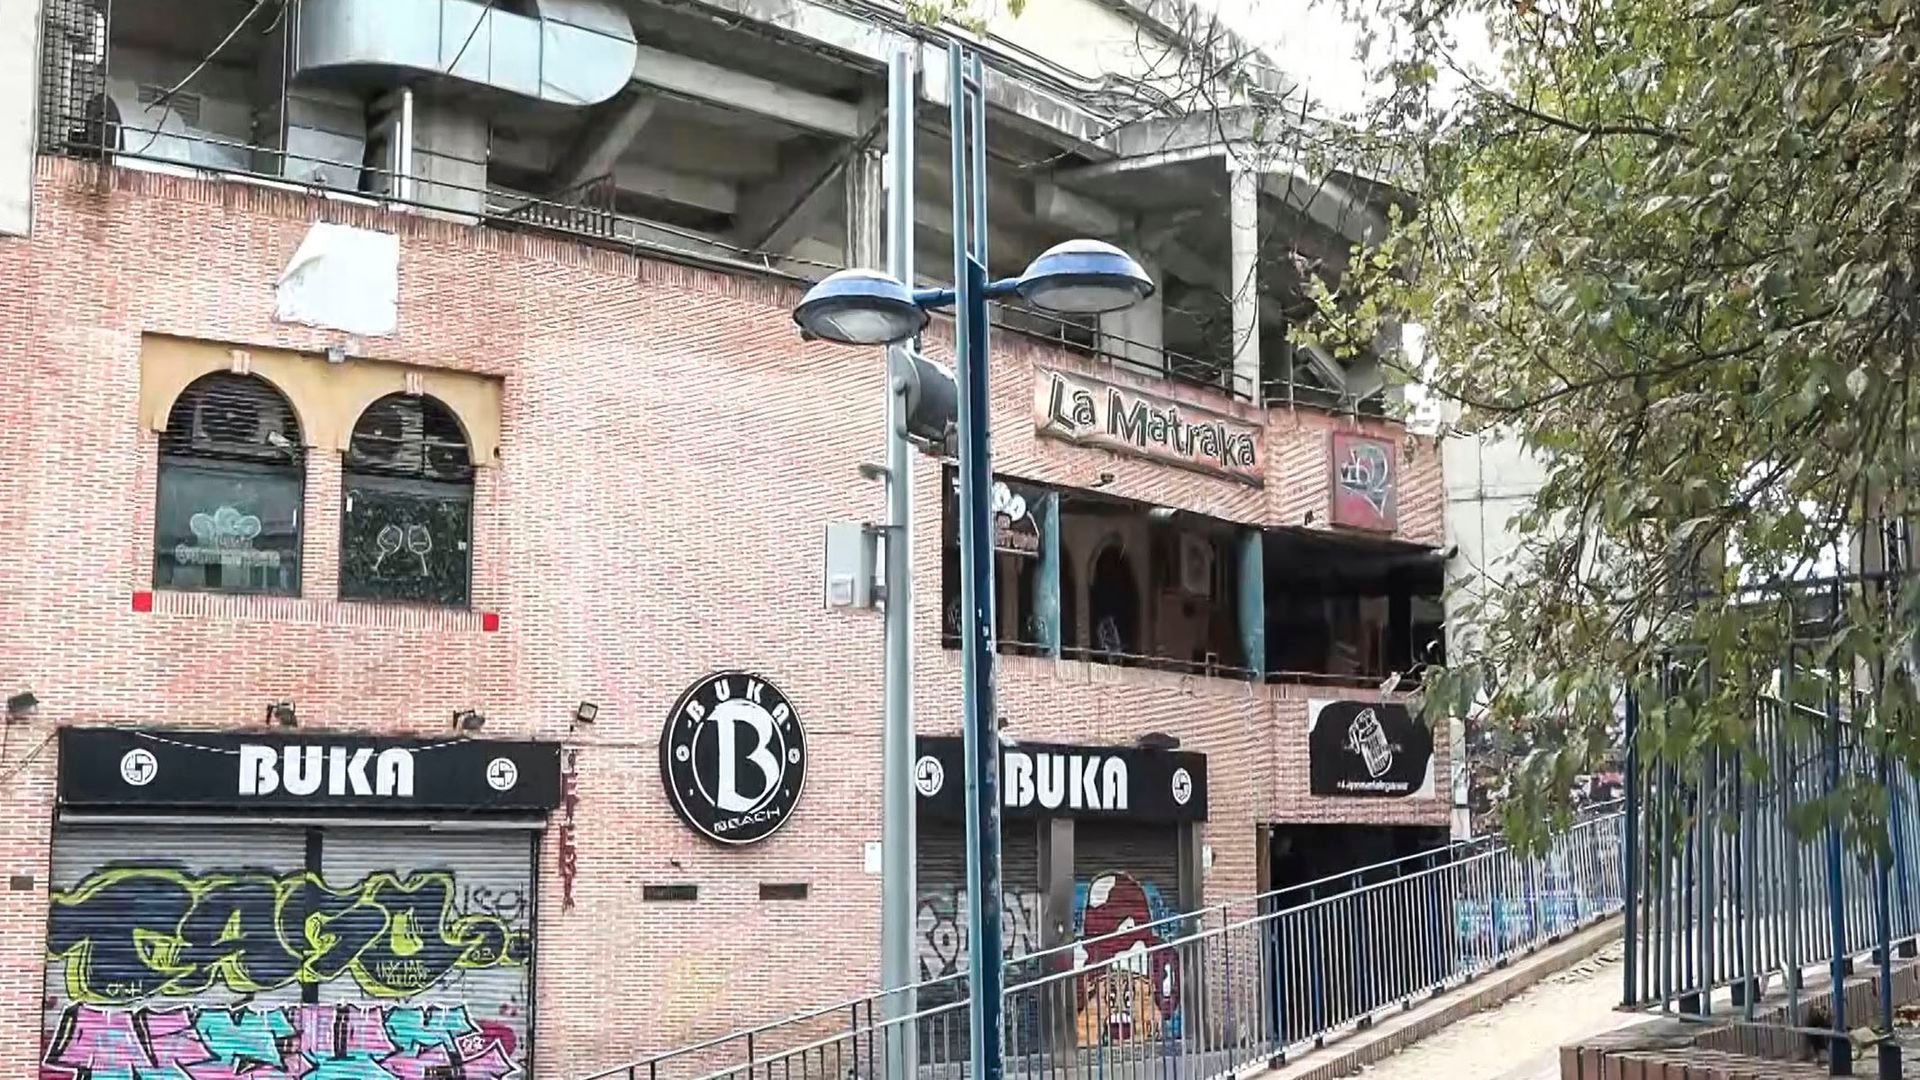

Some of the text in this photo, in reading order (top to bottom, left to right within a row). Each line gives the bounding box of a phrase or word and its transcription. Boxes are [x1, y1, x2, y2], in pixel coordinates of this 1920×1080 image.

[1048, 372, 1096, 432] La
[1107, 387, 1256, 468] Matraka
[686, 679, 789, 726] BUKA
[239, 744, 414, 796] BUKA
[707, 698, 780, 813] B
[1004, 752, 1128, 810] BUKA
